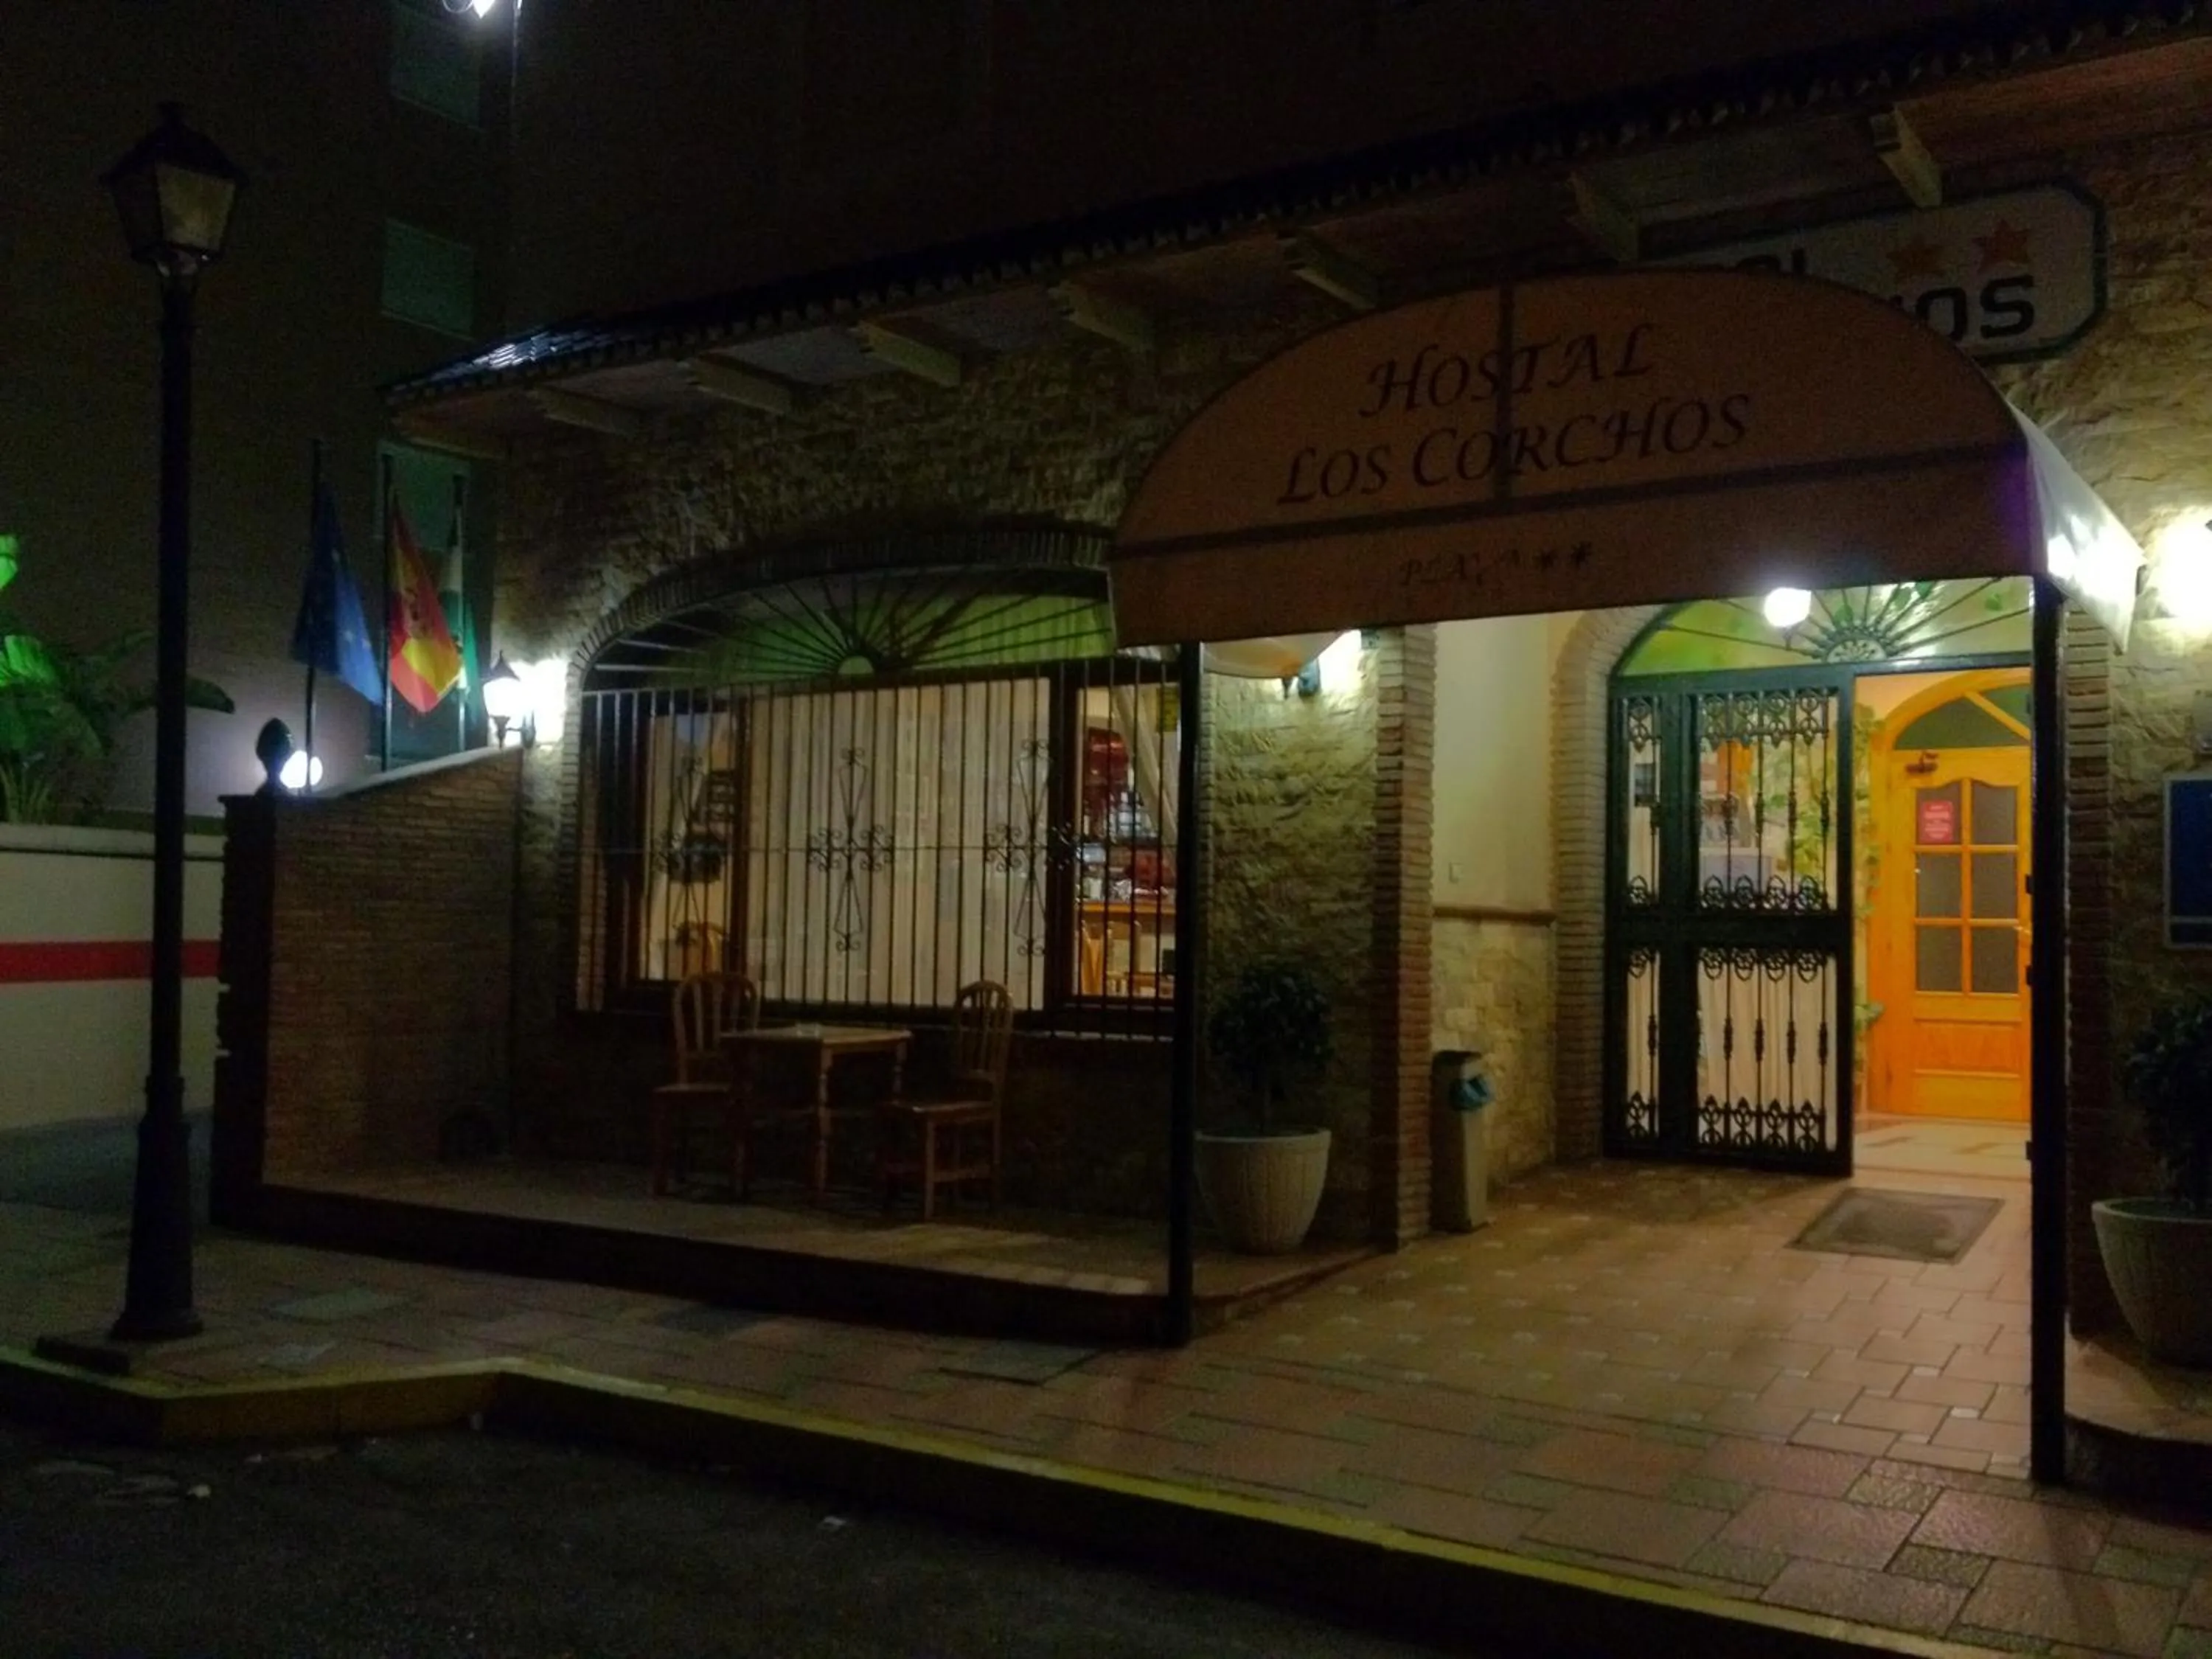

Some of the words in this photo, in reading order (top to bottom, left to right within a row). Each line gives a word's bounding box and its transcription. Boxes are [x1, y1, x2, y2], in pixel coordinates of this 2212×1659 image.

[1360, 322, 1657, 417] HOSTAL
[1277, 446, 1391, 504] LOS
[1413, 393, 1750, 487] CORCHOS
